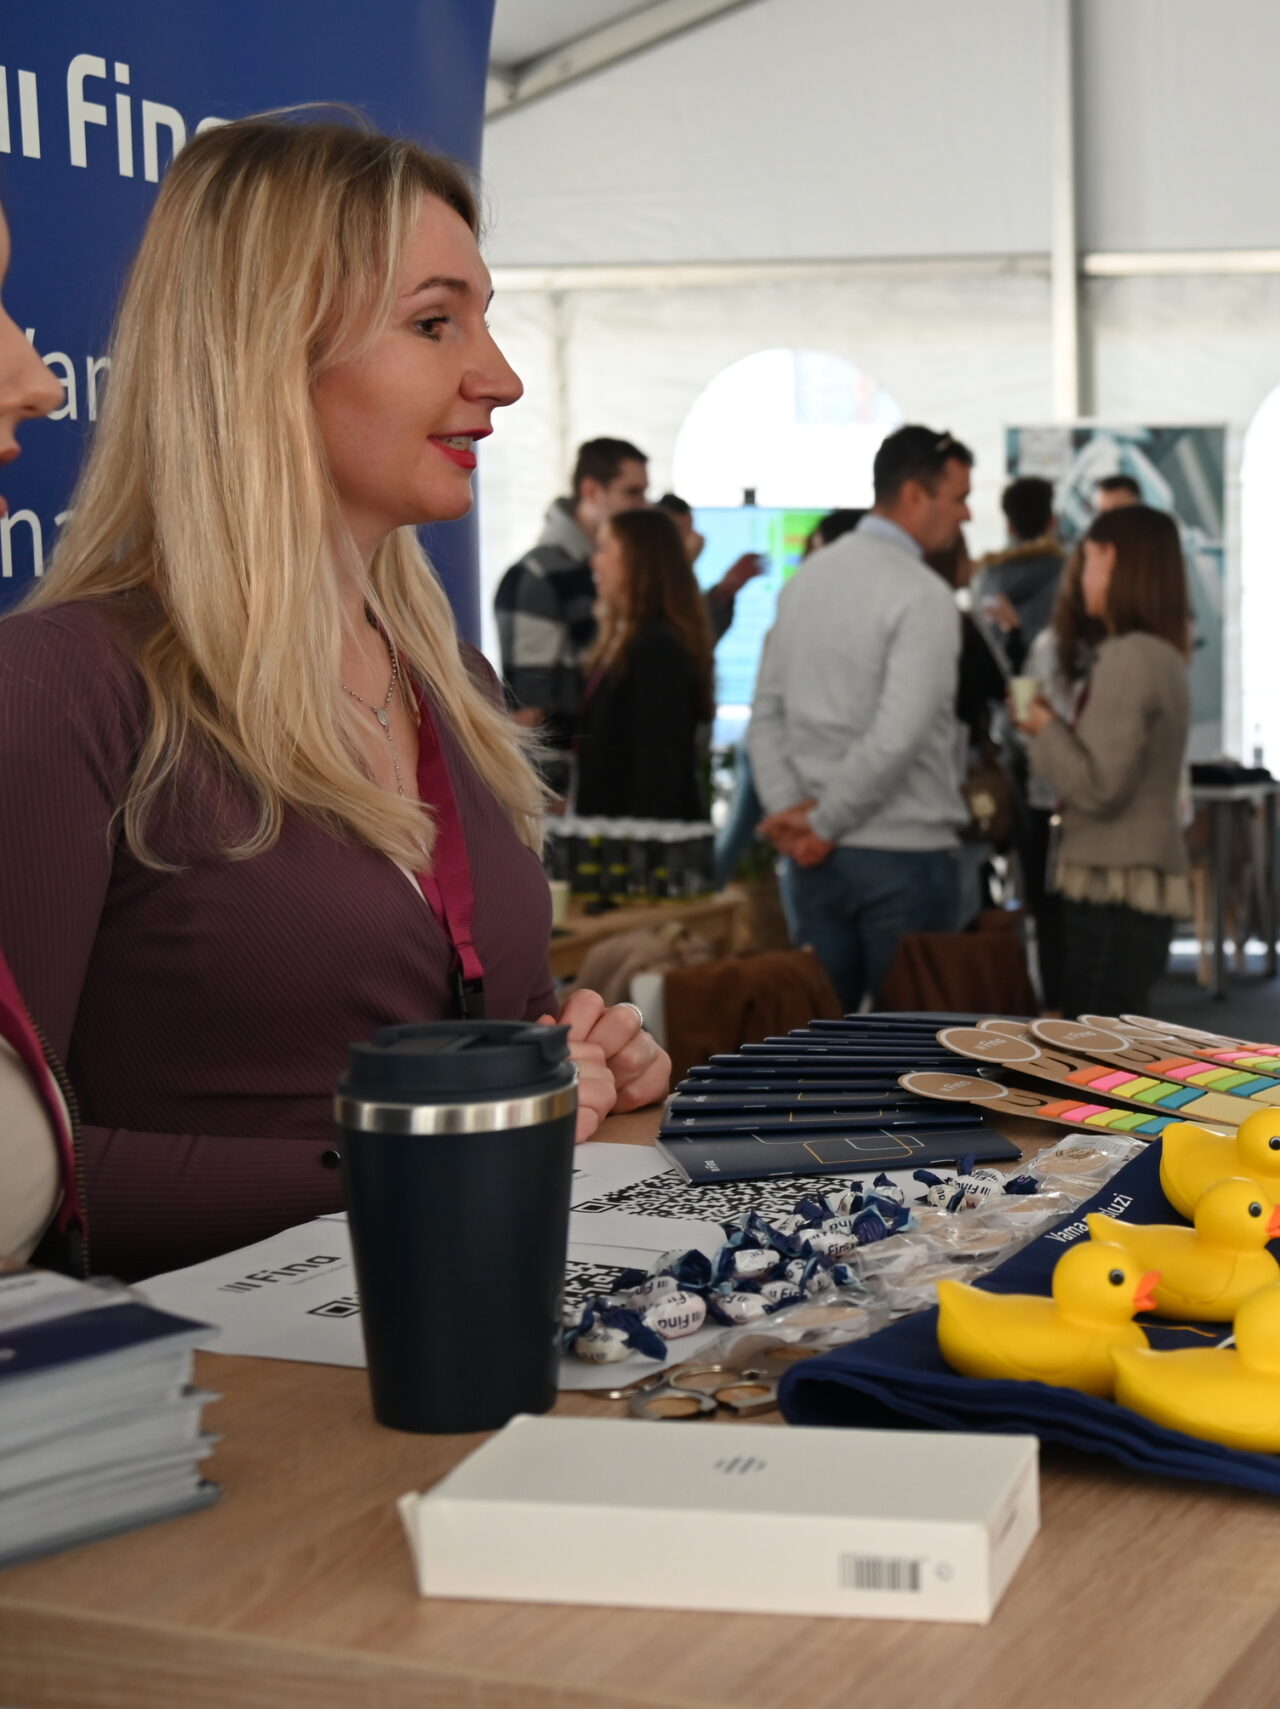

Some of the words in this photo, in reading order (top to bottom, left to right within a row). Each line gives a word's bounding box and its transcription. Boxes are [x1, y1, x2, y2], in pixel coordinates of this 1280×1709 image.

[67, 53, 238, 183] Fin
[1044, 1220, 1088, 1242] Vama
[1098, 1192, 1134, 1218] luzi
[245, 1255, 342, 1283] Fina
